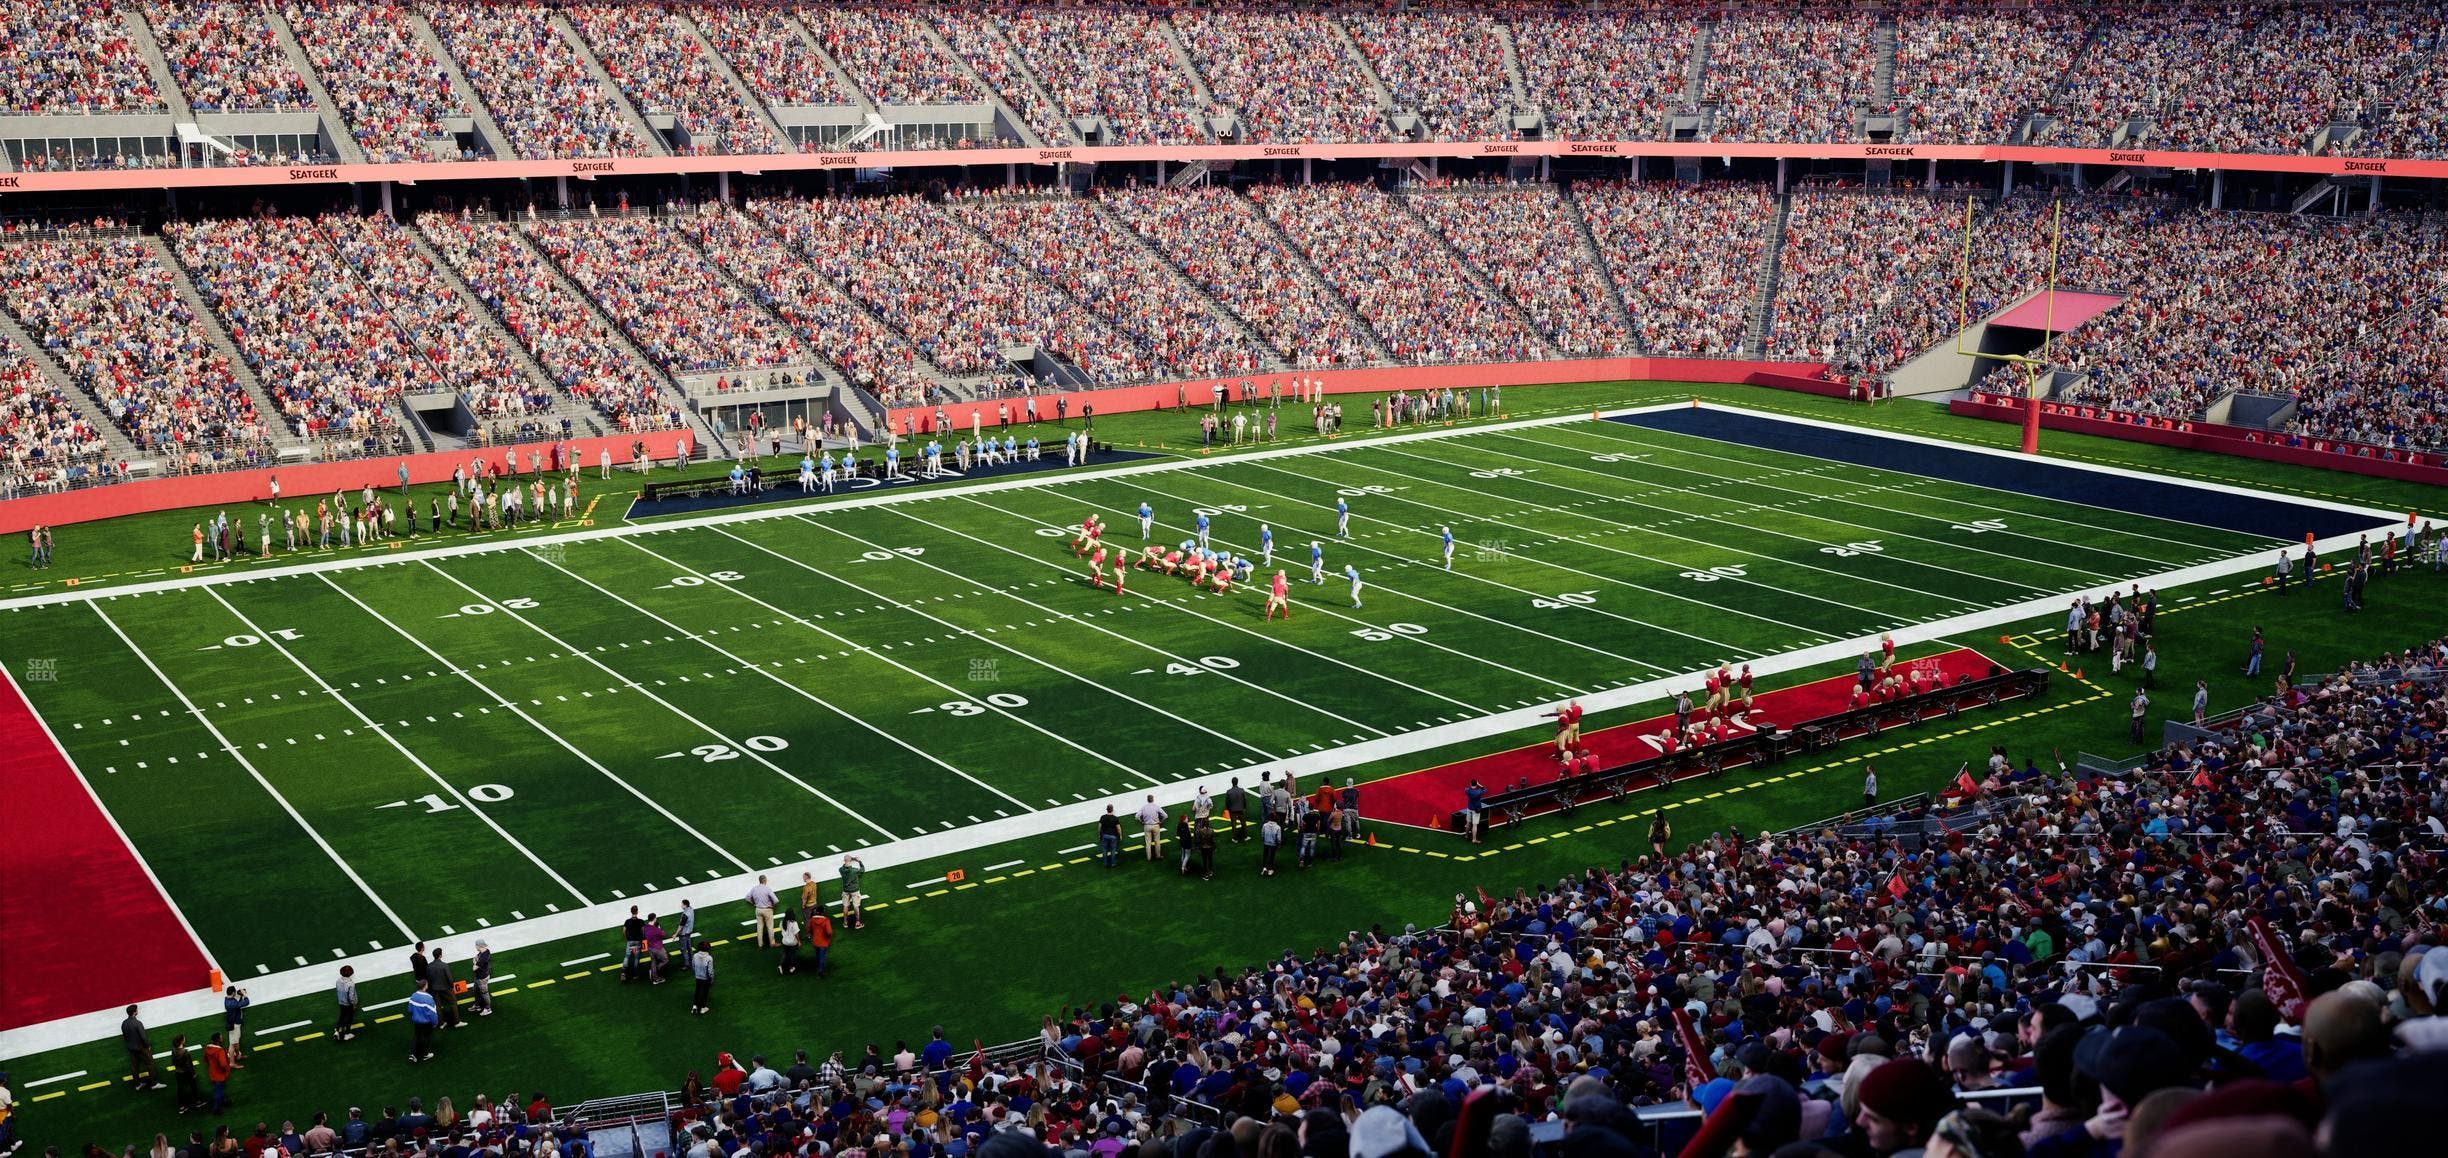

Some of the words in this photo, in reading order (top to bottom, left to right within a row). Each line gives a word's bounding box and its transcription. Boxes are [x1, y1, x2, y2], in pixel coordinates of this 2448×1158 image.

[1264, 147, 1300, 156] SEATGEEK
[1484, 145, 1519, 154] SEATGEEK
[1571, 144, 1617, 153] SEATGEEK
[1866, 146, 1914, 156] SEATGEEK
[820, 155, 857, 166] SEATGEEK
[1039, 150, 1072, 160] SEATGEEK
[2109, 152, 2145, 163] SEATGEEK
[572, 162, 615, 173] SEATGEEK
[2344, 161, 2386, 172] SEATGEEK
[289, 168, 338, 180] SEATGEEK
[1951, 519, 2008, 534] 10
[1822, 542, 1884, 557] 20
[1679, 566, 1748, 582] 30
[1532, 592, 1597, 609] 40
[1349, 623, 1429, 641] 50
[1165, 656, 1240, 676] 40
[939, 693, 1029, 717] 30
[690, 735, 789, 763] 20
[413, 783, 515, 814] 10
